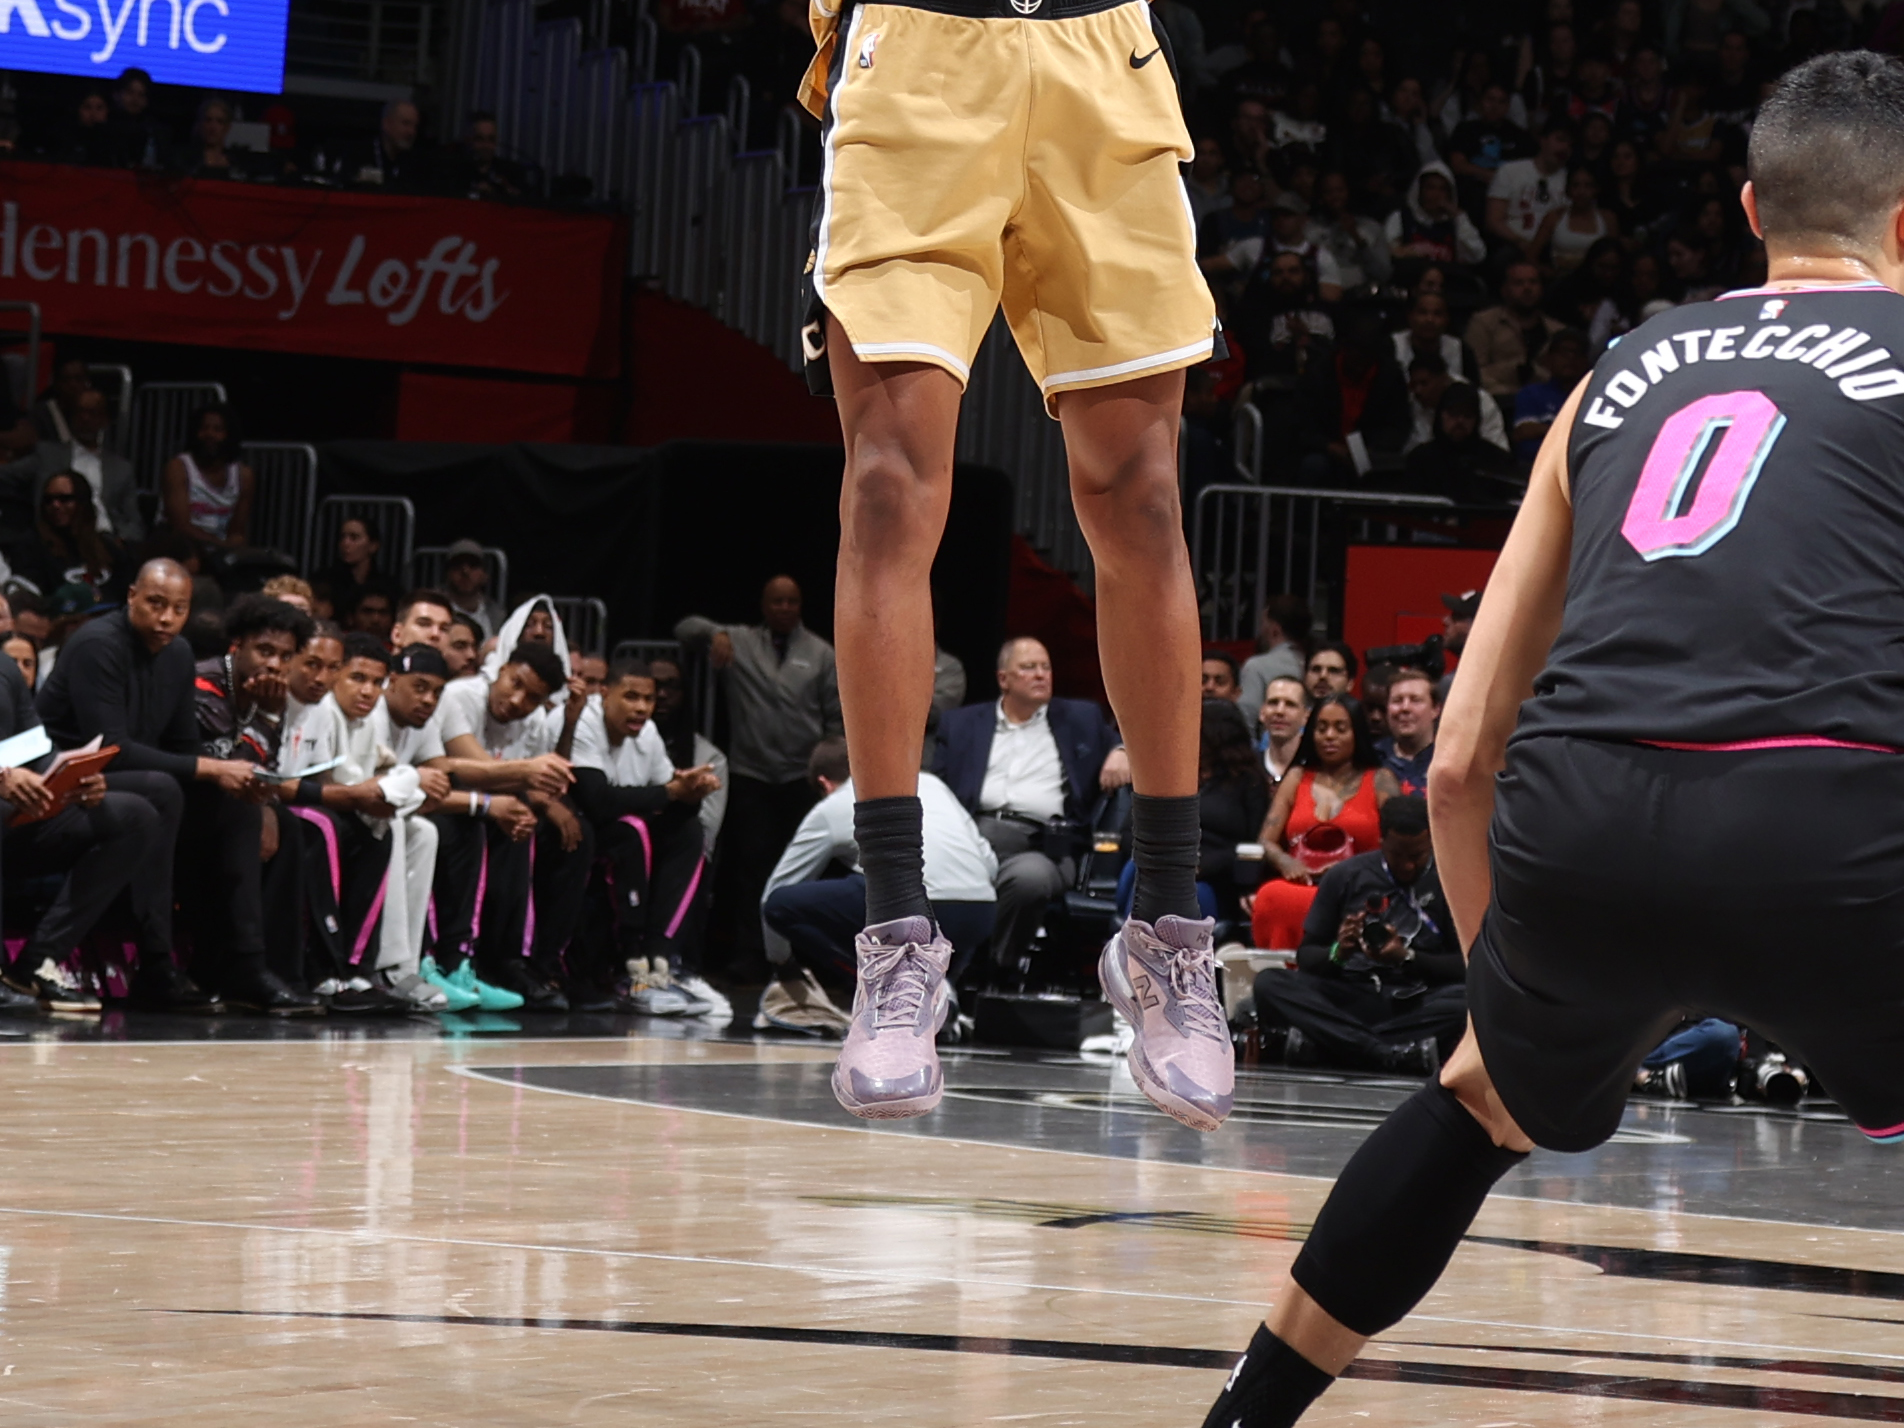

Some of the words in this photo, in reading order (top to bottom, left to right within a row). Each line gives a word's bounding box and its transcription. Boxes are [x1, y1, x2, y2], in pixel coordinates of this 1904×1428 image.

[326, 234, 511, 326] Lofts
[1583, 324, 1904, 429] FONTECCHIO
[1621, 390, 1787, 562] 0
